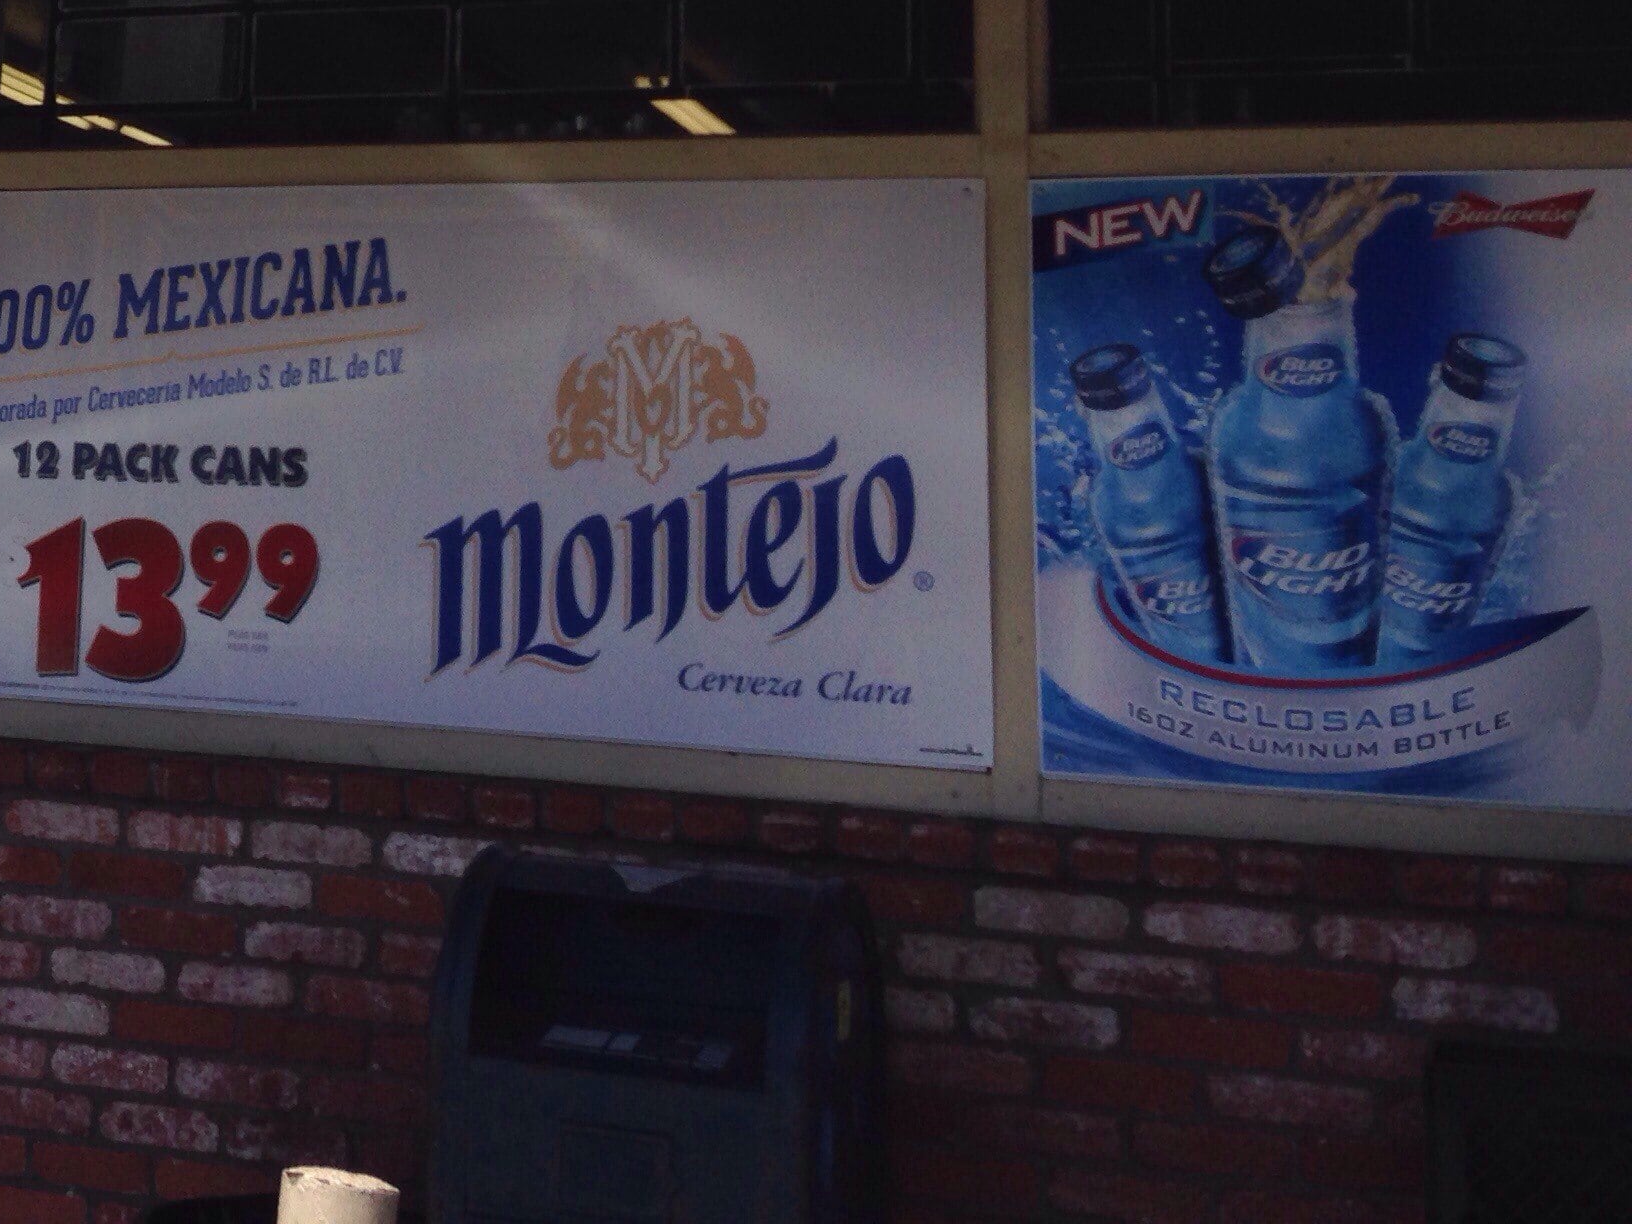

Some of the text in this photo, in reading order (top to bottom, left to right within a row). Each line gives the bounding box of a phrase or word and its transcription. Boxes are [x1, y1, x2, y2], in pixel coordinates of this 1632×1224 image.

[1054, 189, 1203, 257] NEW
[113, 237, 408, 341] MEXICANA.
[52, 396, 82, 424] por
[187, 367, 252, 400] Modelo
[280, 362, 302, 388] de
[346, 351, 369, 379] de
[1278, 356, 1336, 372] BUD
[13, 440, 309, 488] 12 PACK CANS
[419, 435, 917, 684] Montejo
[1259, 541, 1370, 572] BUD
[1157, 576, 1211, 598] BU
[1384, 564, 1473, 598] BUD
[678, 663, 912, 705] Cerveza Clara
[1159, 679, 1476, 733] RECLOSABLE
[1208, 729, 1380, 759] ALUMINUM
[1393, 710, 1512, 755] BOTTLE
